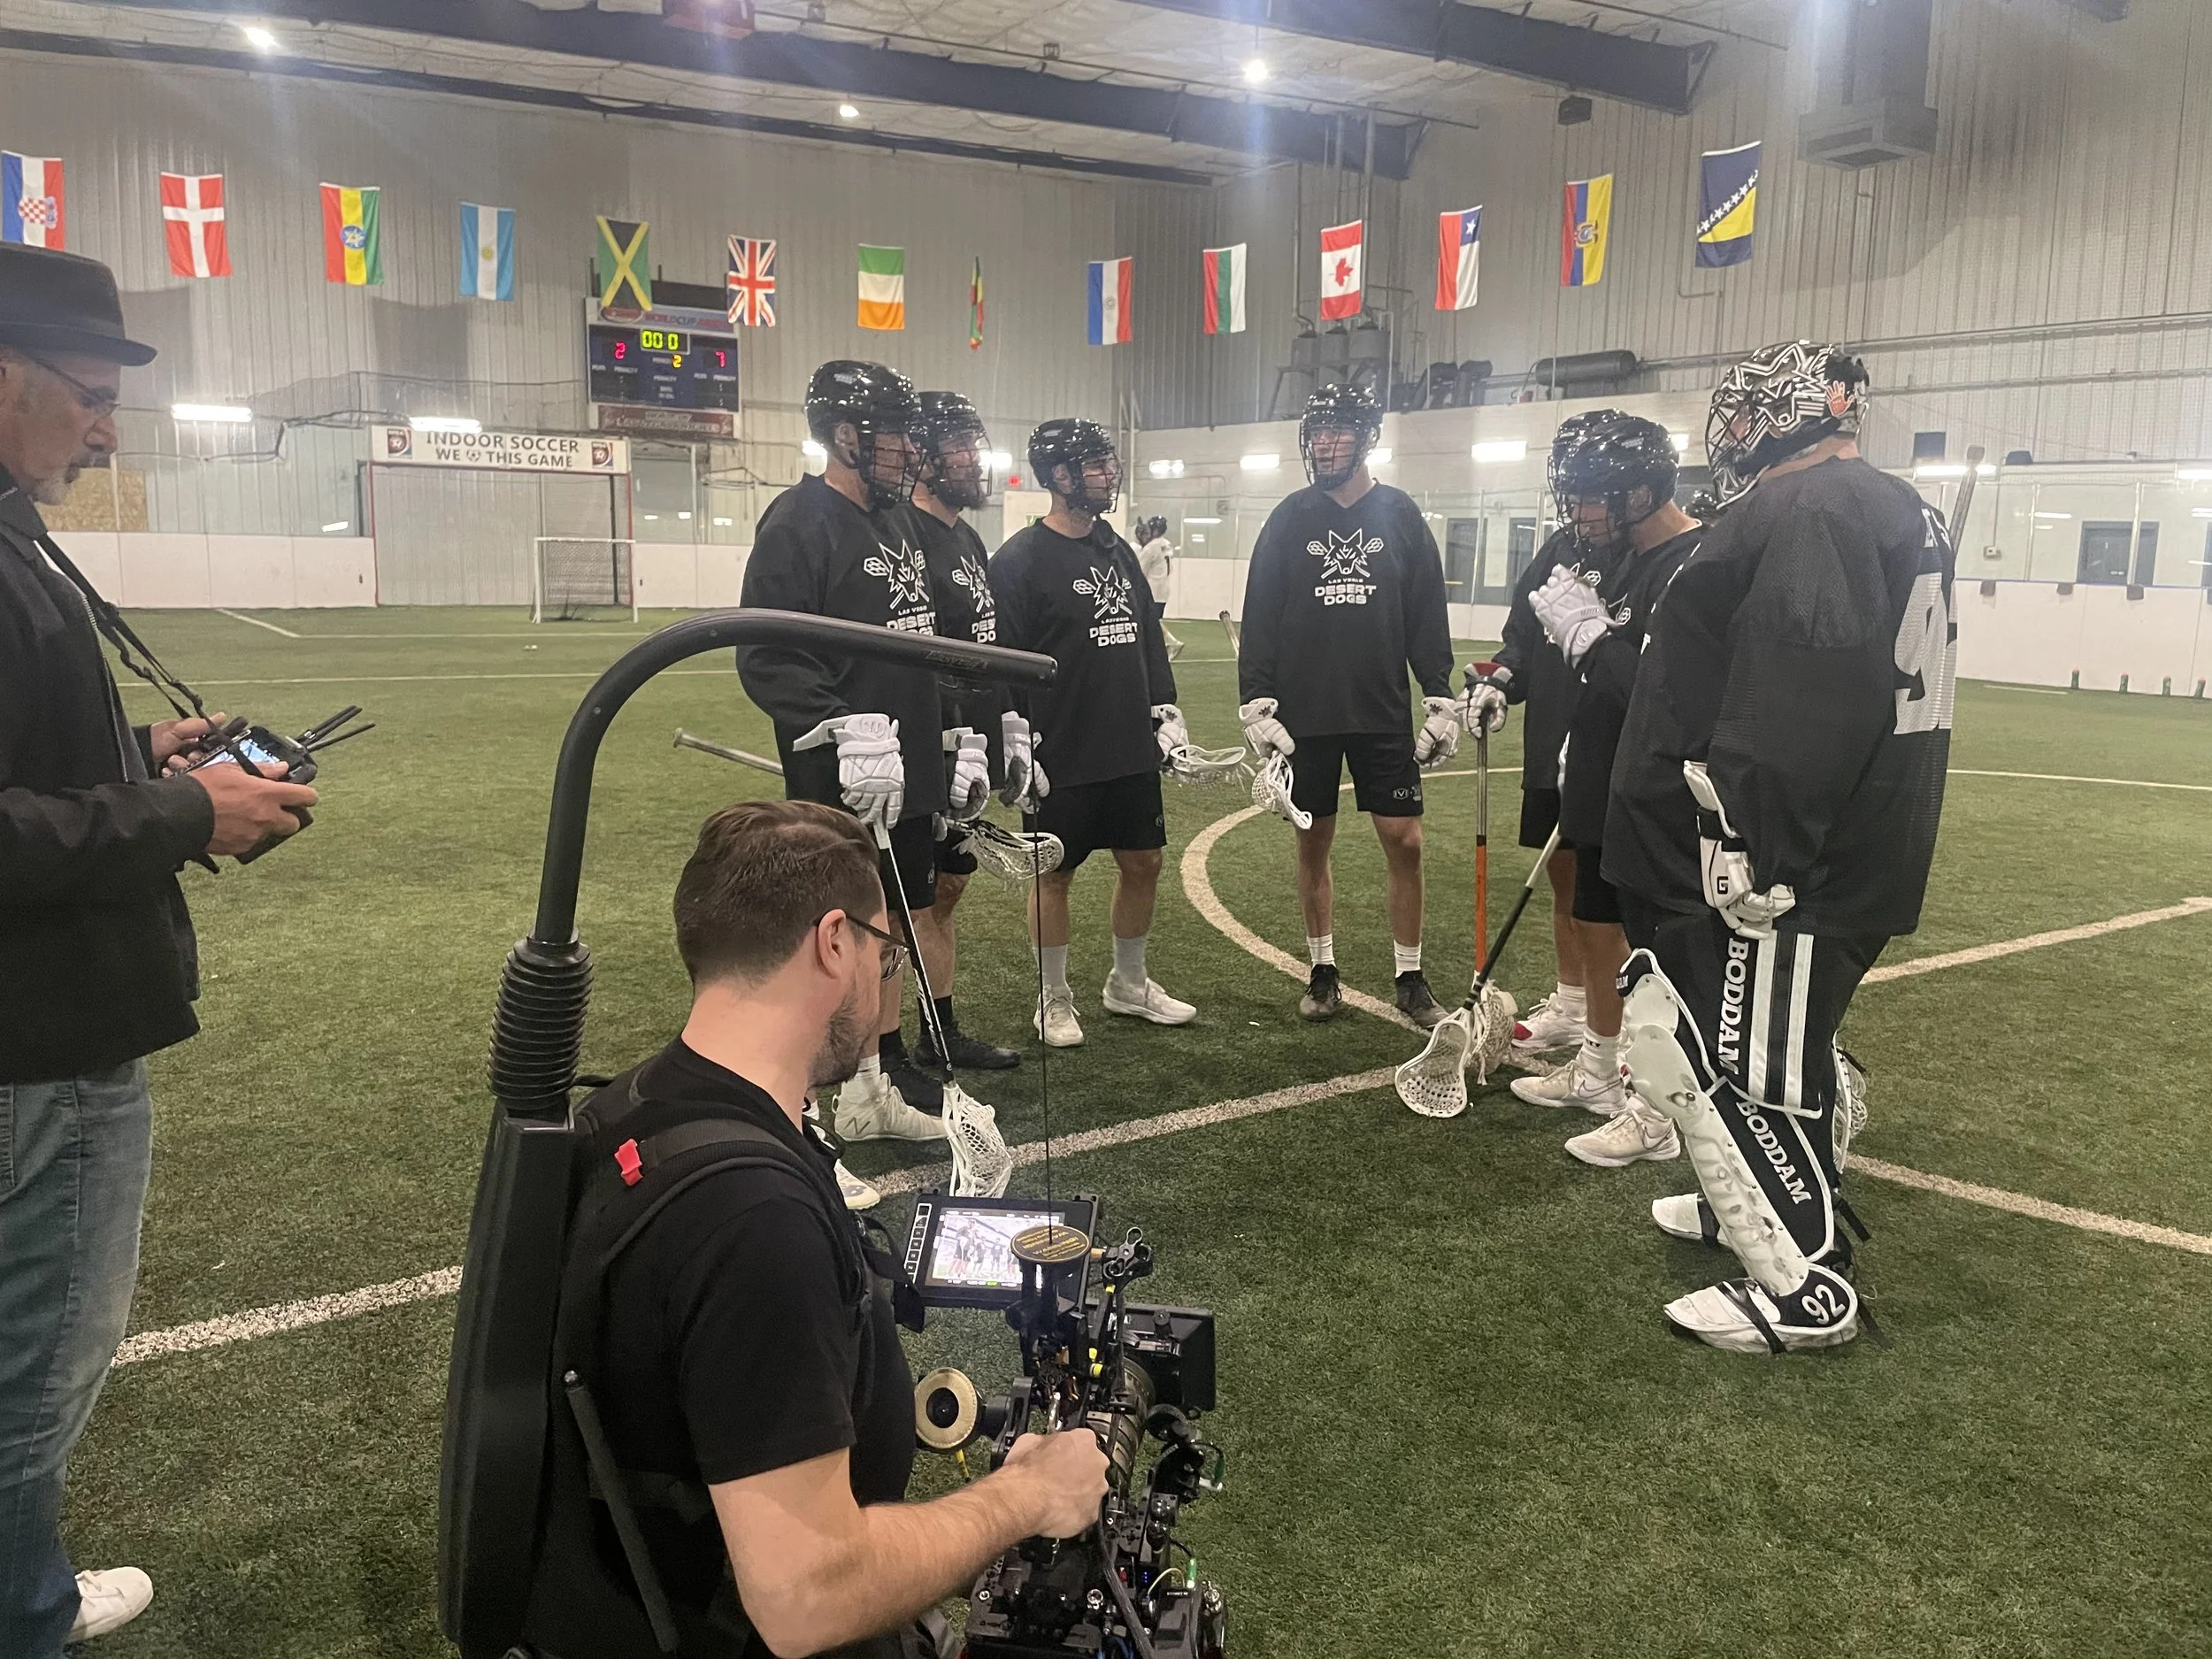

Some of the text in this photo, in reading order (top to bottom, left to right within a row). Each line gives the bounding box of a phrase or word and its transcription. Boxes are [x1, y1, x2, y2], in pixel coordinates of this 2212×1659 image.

[614, 342, 626, 360] 2
[672, 354, 683, 369] 2
[426, 431, 580, 454] INDOOR SOCCER
[435, 448, 573, 468] WE THIS GAME
[1314, 583, 1377, 597] DESERT
[1324, 594, 1367, 606] DOGS
[1089, 622, 1138, 639] DESERT
[1097, 633, 1136, 647] DOGS
[1717, 876, 1729, 895] G
[1717, 937, 1749, 1076] BODDAM
[1735, 1101, 1812, 1205] BODDAM
[1801, 1284, 1847, 1325] 92
